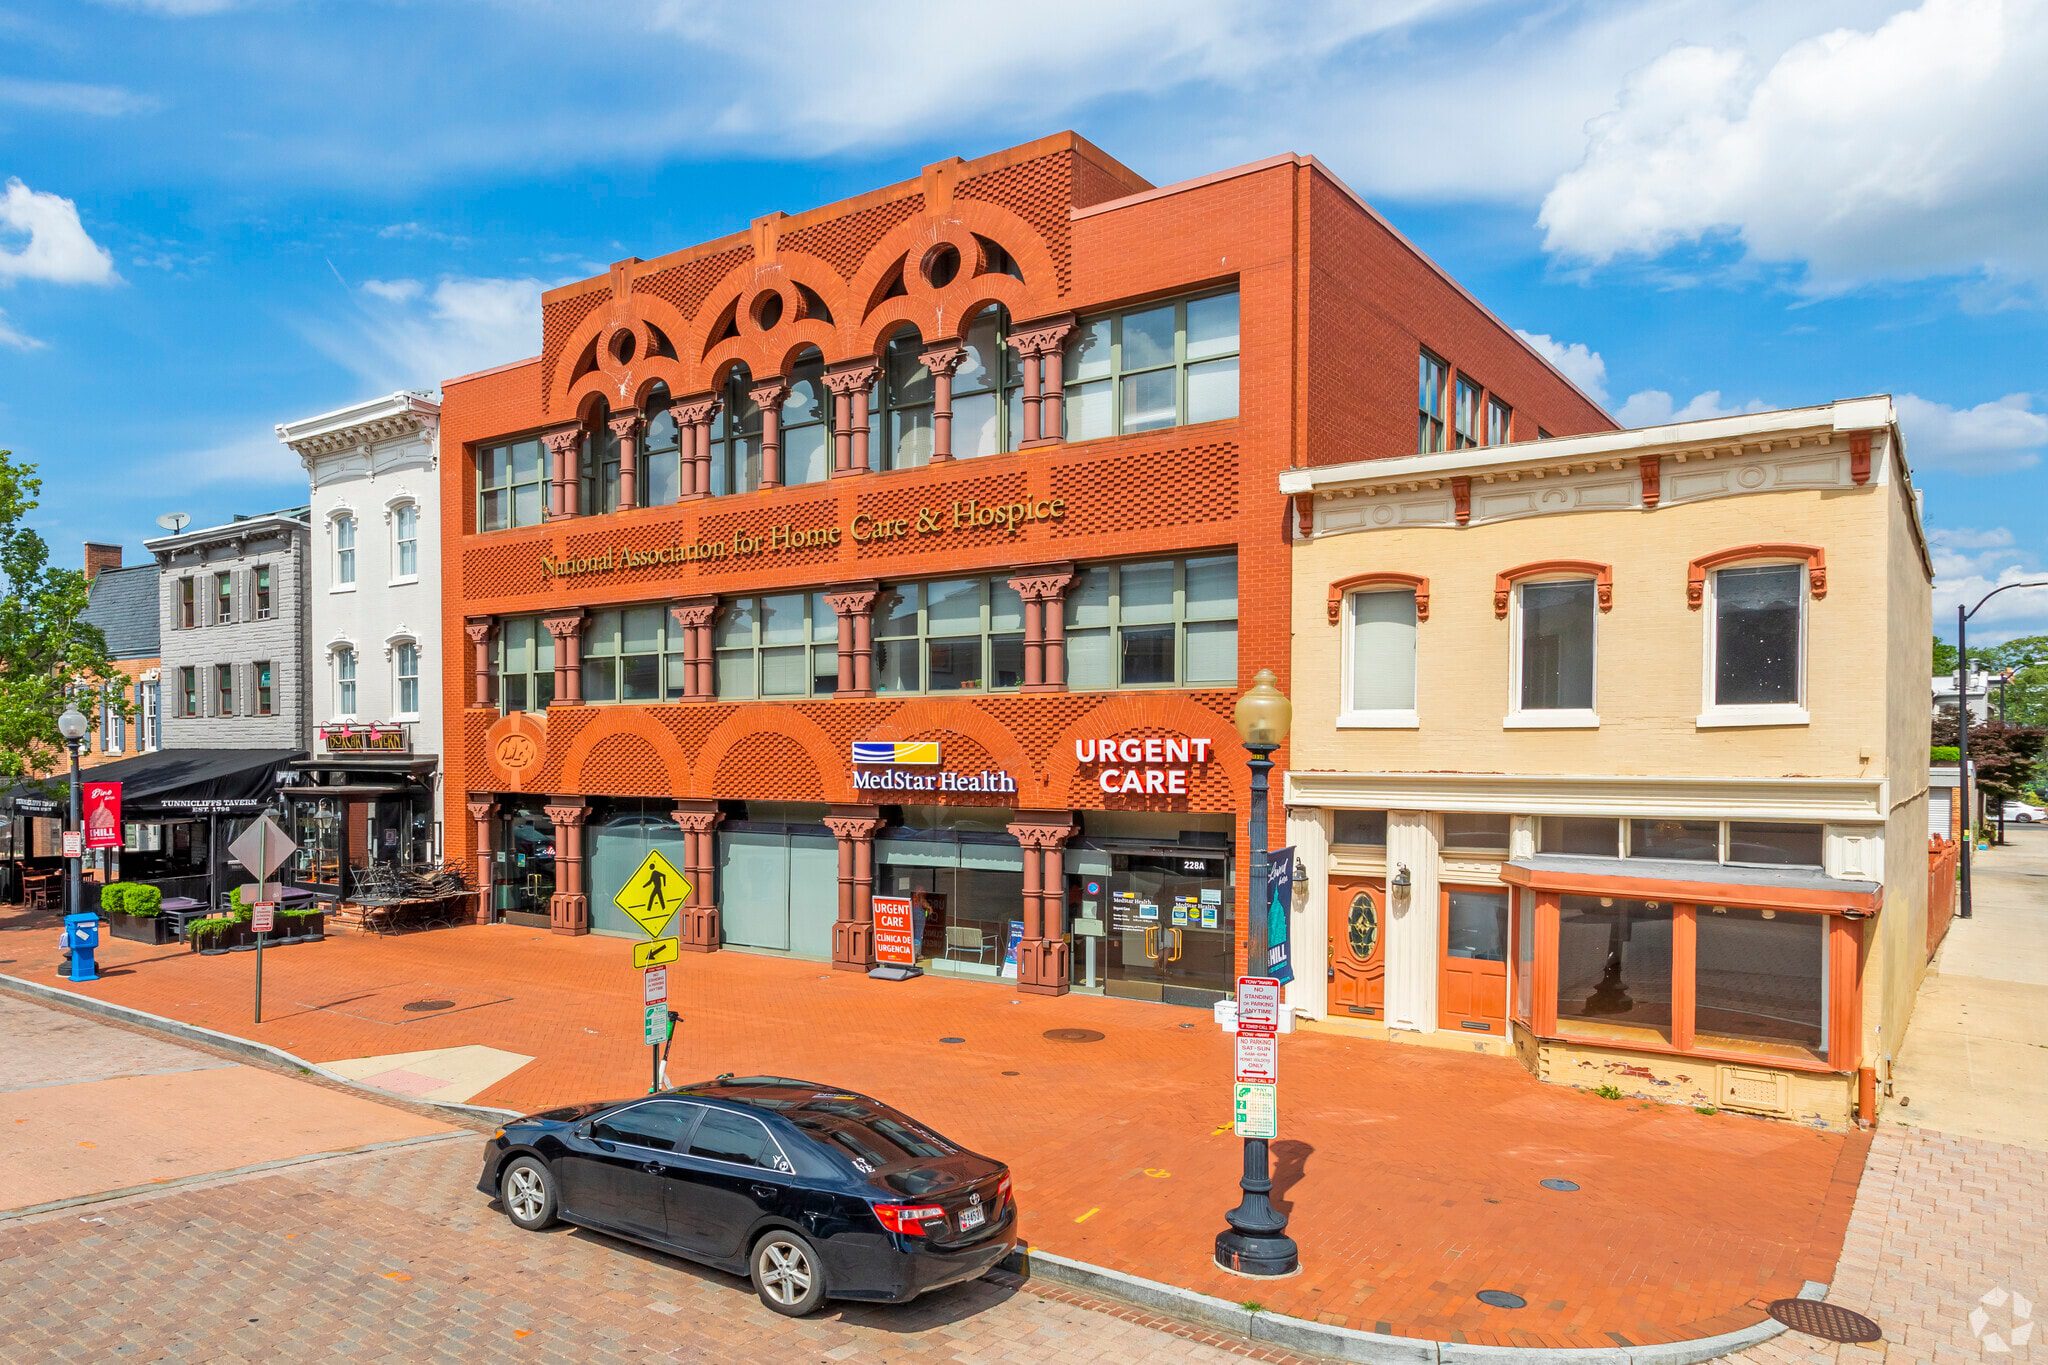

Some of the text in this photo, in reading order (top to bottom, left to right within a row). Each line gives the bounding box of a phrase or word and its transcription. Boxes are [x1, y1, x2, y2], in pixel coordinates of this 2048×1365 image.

[541, 494, 1065, 578] National Association for Home Care & Hospice
[1075, 738, 1212, 763] URGENT
[852, 769, 1016, 792] MedStar Health
[1099, 769, 1187, 794] CARE
[1184, 861, 1205, 870] 228A
[874, 903, 909, 915] URGENT
[881, 915, 903, 927] CARE
[876, 933, 911, 944] CLÍNICA DE
[878, 944, 911, 954] URGENCIA
